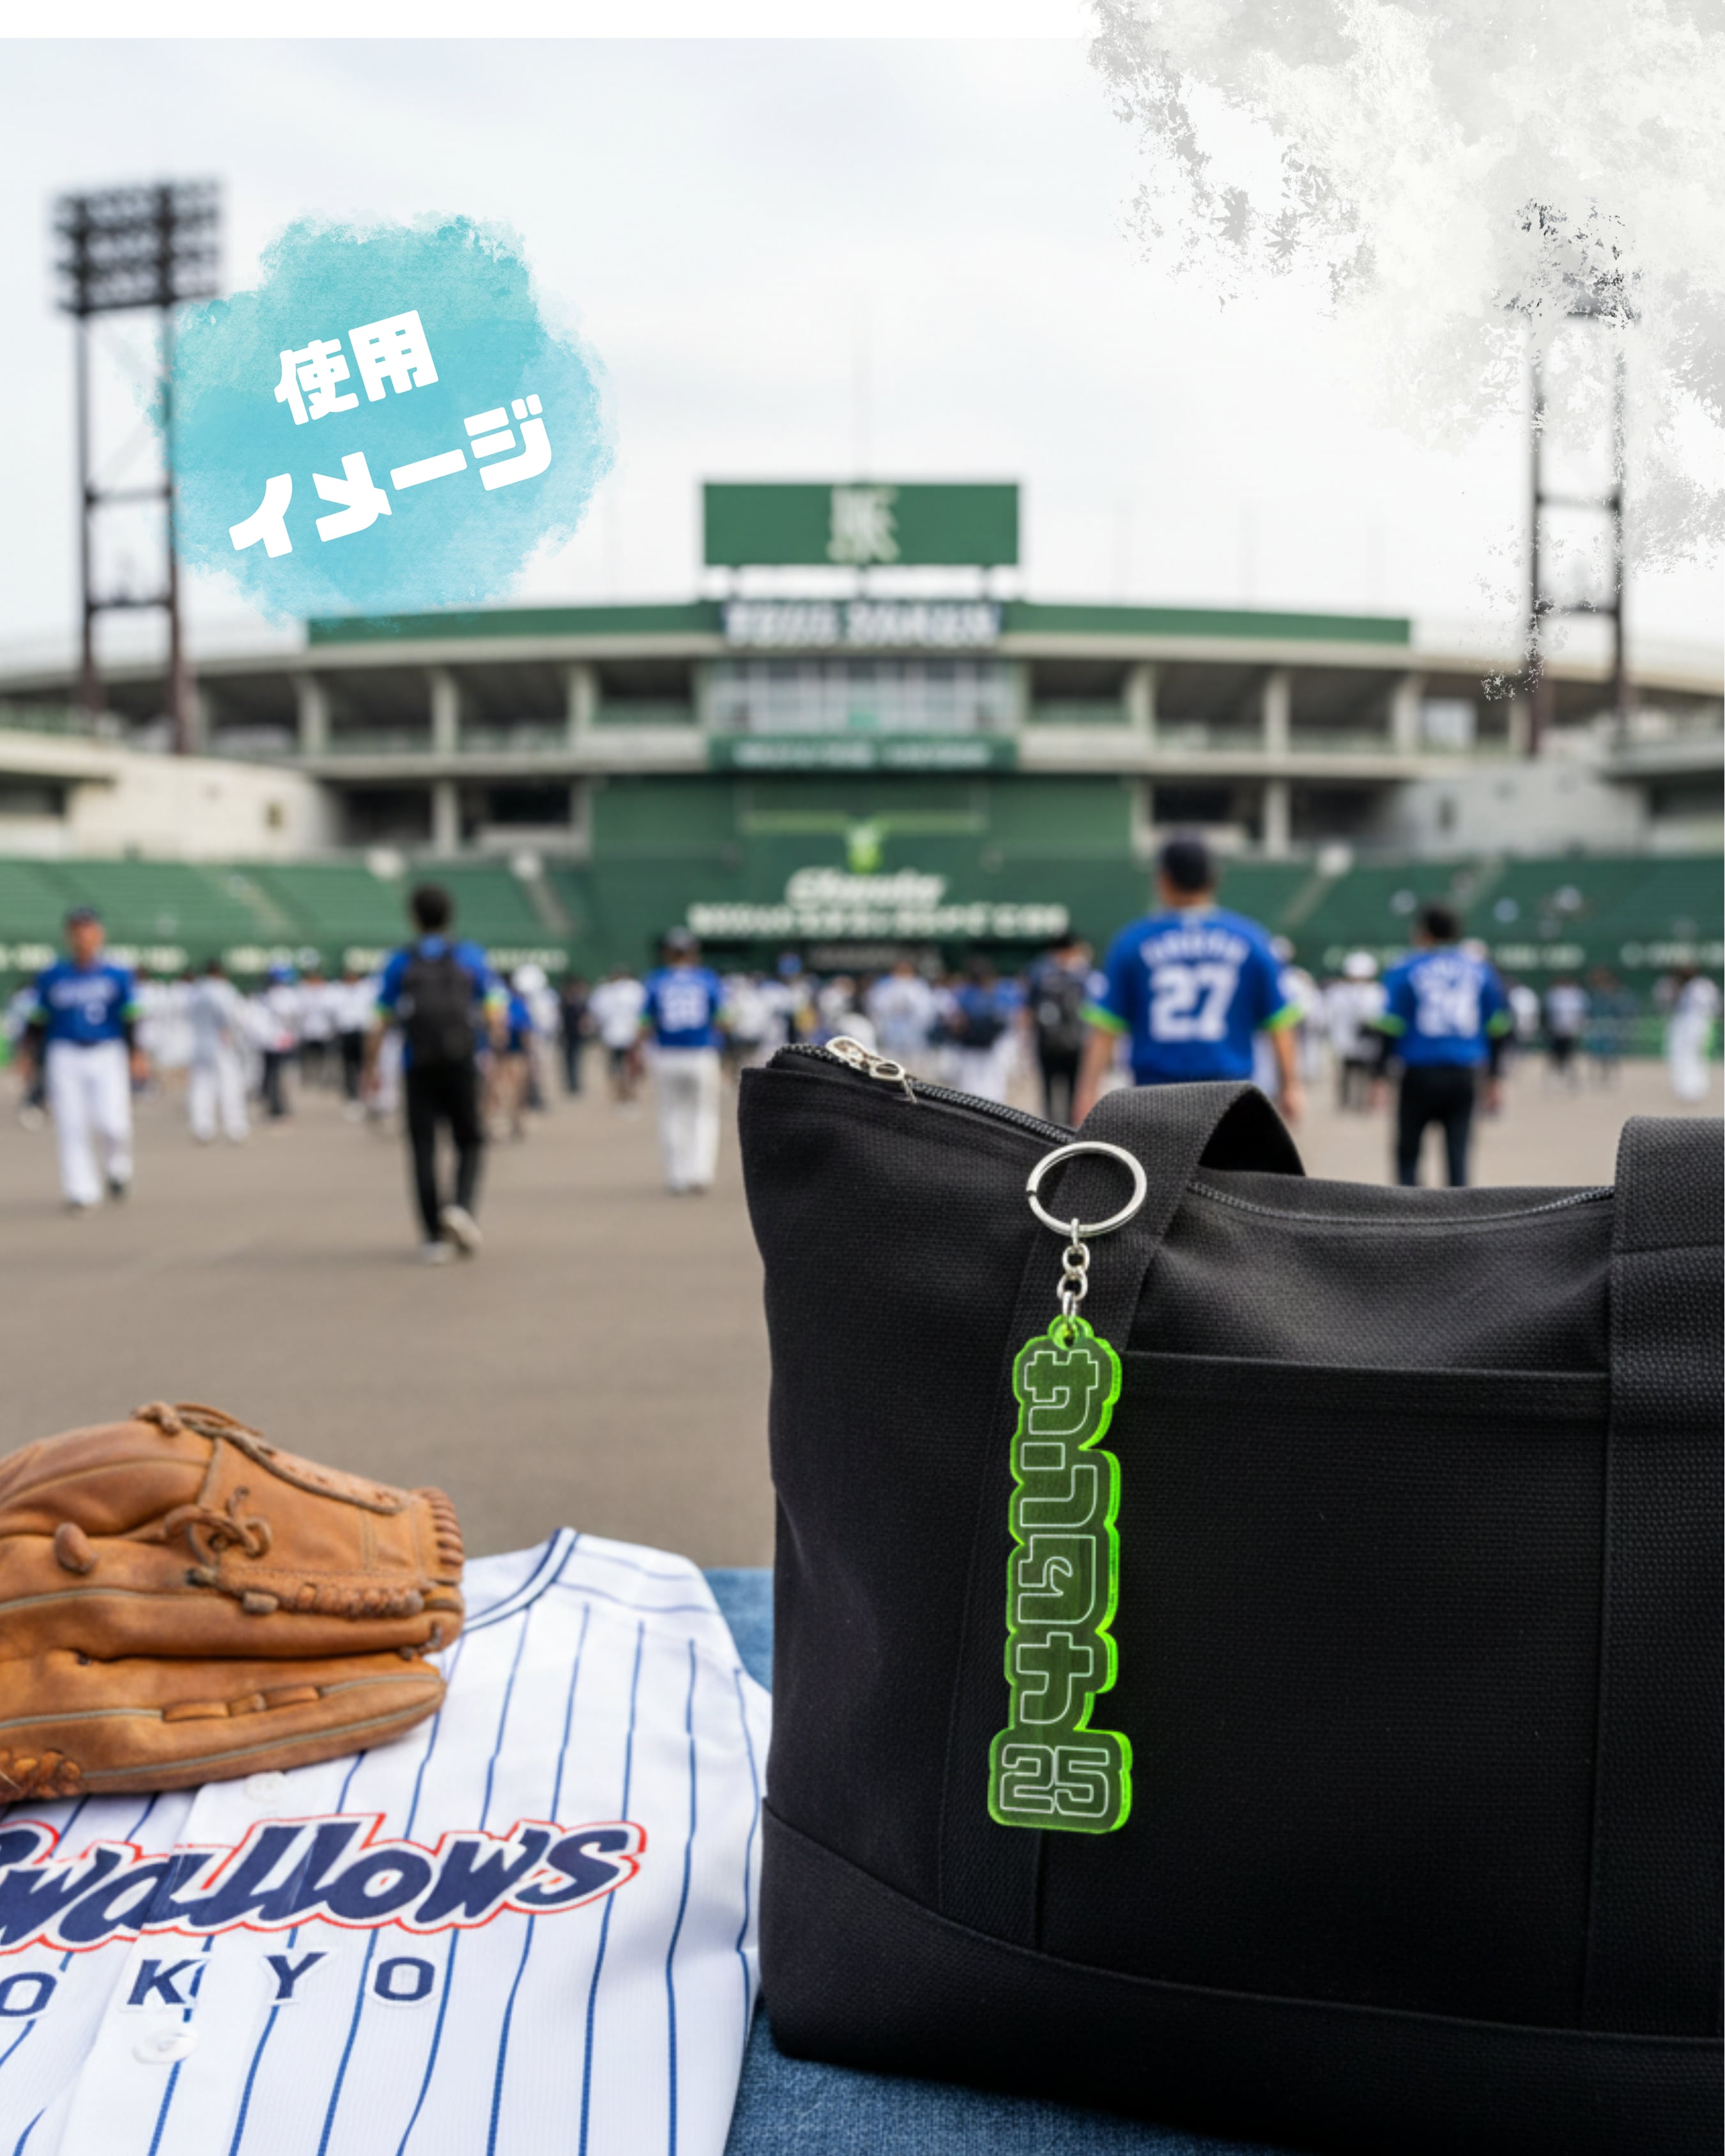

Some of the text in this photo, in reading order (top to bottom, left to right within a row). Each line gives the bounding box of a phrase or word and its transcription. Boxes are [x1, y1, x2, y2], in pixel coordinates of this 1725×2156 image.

[1150, 961, 1241, 1043] 27
[1016, 1349, 1099, 1725] サンタナ
[999, 1743, 1110, 1818] 25
